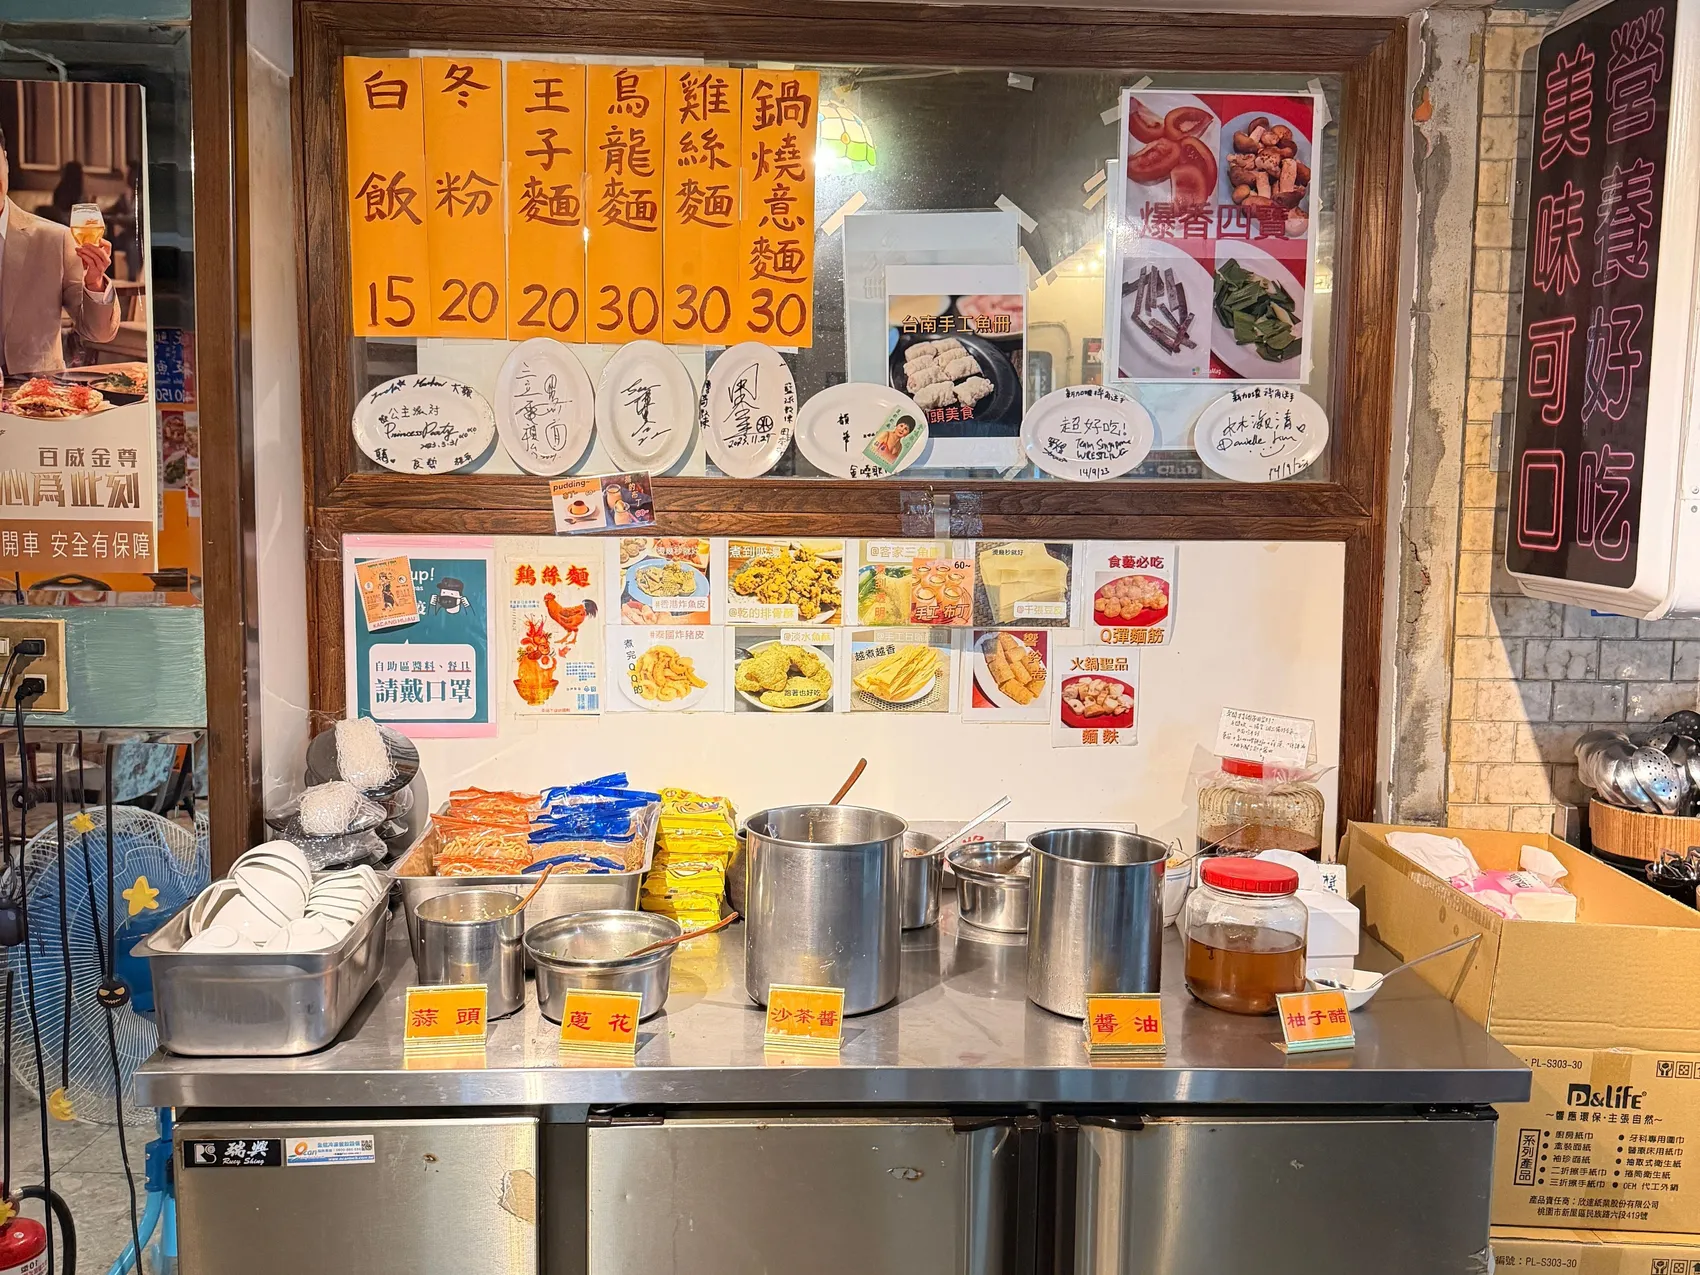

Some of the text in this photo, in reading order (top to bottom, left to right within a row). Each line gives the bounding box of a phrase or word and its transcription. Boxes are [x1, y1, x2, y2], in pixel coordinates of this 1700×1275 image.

[354, 69, 423, 226] 白飯
[435, 63, 499, 218] 冬粉
[518, 78, 580, 227] 王子麵
[597, 68, 658, 233] 烏龍麵
[676, 71, 734, 228] 雞絲麵
[748, 78, 812, 284] 鍋燒意麵
[1139, 200, 1290, 241] 爆香四寶
[438, 278, 500, 324] 20
[1516, 42, 1596, 551] 美味可口
[1576, 6, 1665, 561] 營養好吃
[368, 275, 415, 328] 15
[517, 283, 580, 333] 20
[600, 284, 659, 335] 30
[672, 284, 732, 334] 30
[746, 288, 807, 337] 30
[902, 314, 1011, 334] 台南手工魚冊
[927, 406, 974, 424] 頭美食
[38, 446, 138, 468] 百威金尊
[1156, 464, 1198, 475] Club
[2, 530, 151, 559] 開車 安全有保障
[1108, 555, 1165, 569] 食藝必吃
[916, 604, 969, 620] 手工 布丁
[855, 643, 896, 662] 越煮越香
[1070, 657, 1129, 672] 火鍋聖品
[375, 678, 472, 703] 請戴口罩
[411, 1007, 482, 1028] 蒜頭
[770, 1005, 839, 1028] 沙茶醬
[1092, 1012, 1159, 1034] 醬油
[1287, 1007, 1347, 1029] 柚子醋
[1531, 1058, 1583, 1070] PL-S303-30
[1518, 1134, 1536, 1181] 系列產品
[1525, 1256, 1578, 1268] PL-S303-30
